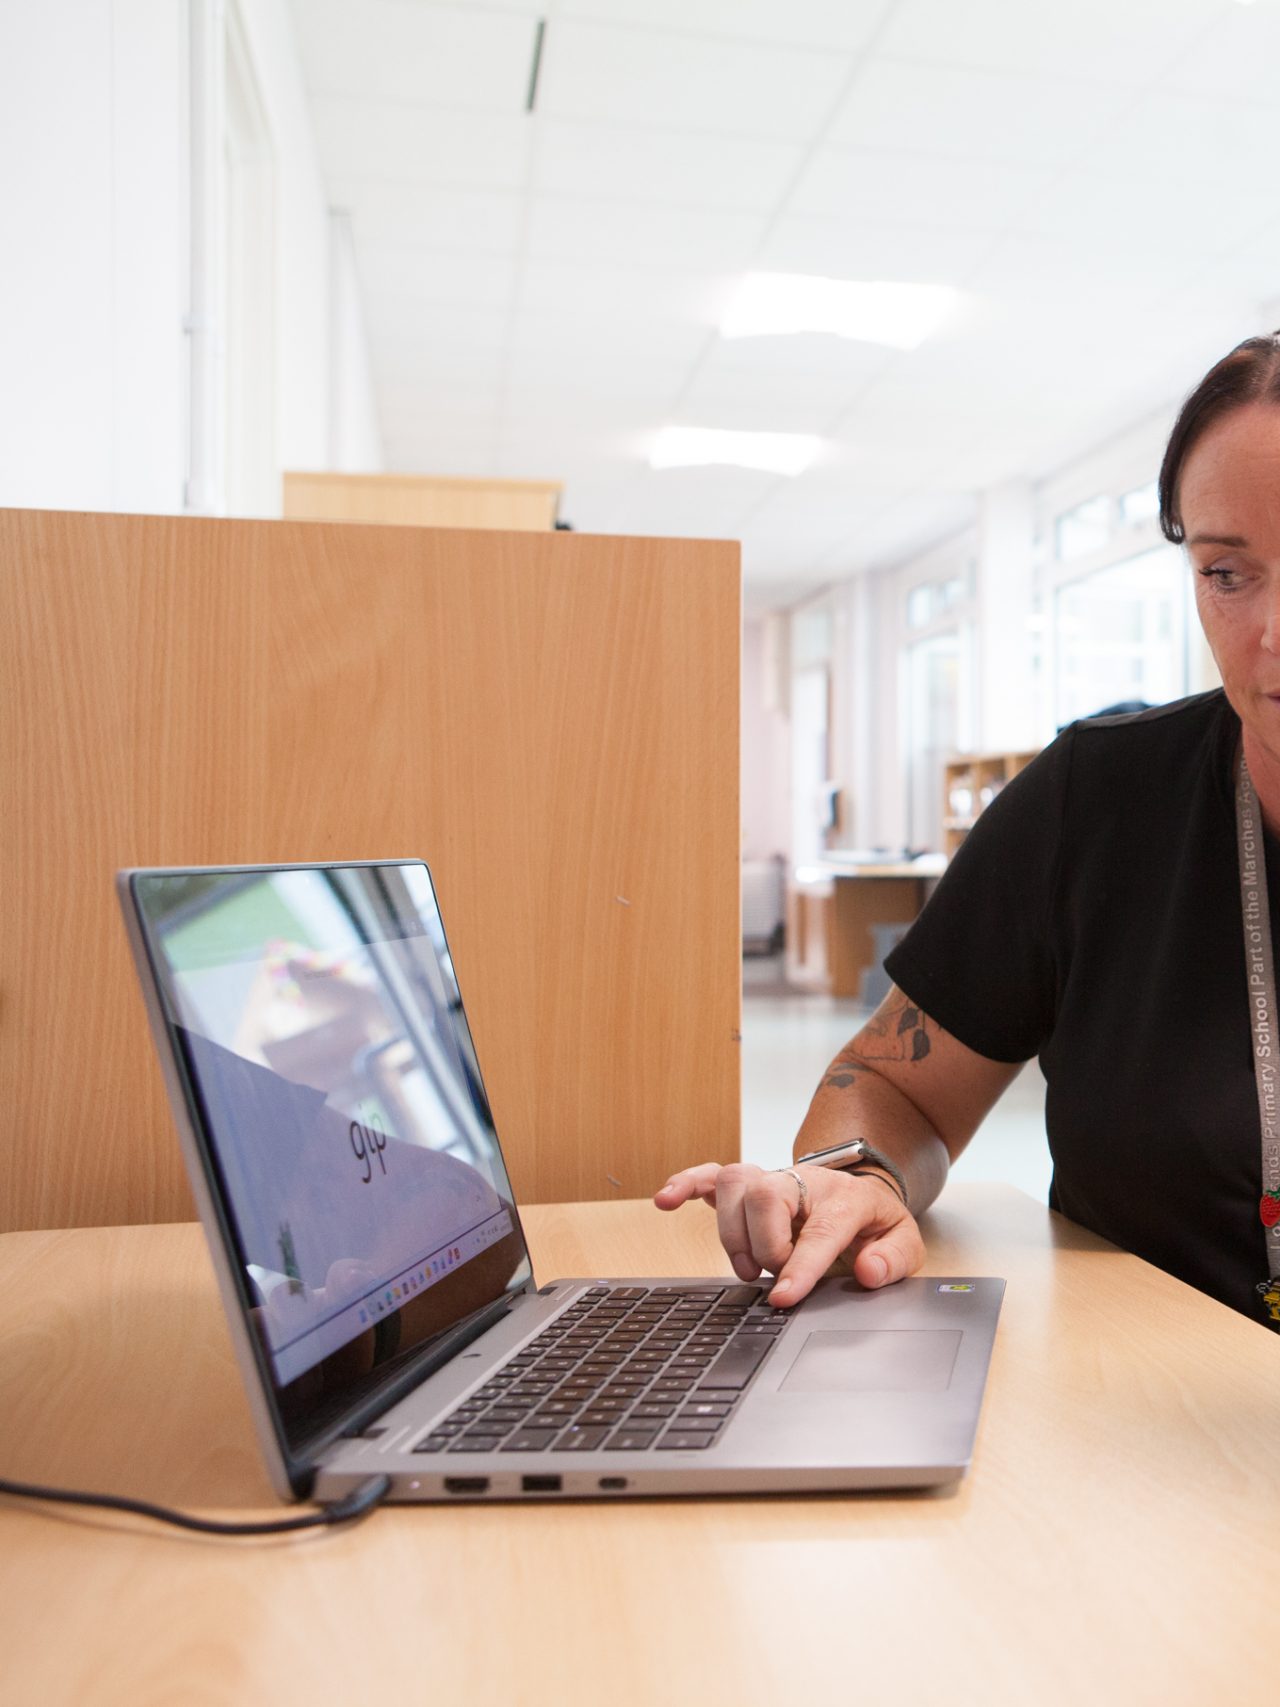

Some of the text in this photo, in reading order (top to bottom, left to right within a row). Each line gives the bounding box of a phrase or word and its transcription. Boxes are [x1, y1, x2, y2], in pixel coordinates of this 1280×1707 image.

[1242, 808, 1257, 886] Marches
[1245, 891, 1260, 920] the
[1246, 924, 1262, 943] of
[1250, 947, 1265, 986] Part
[1252, 991, 1271, 1058] School
[1261, 1062, 1277, 1139] Primary
[350, 1104, 387, 1184] gip
